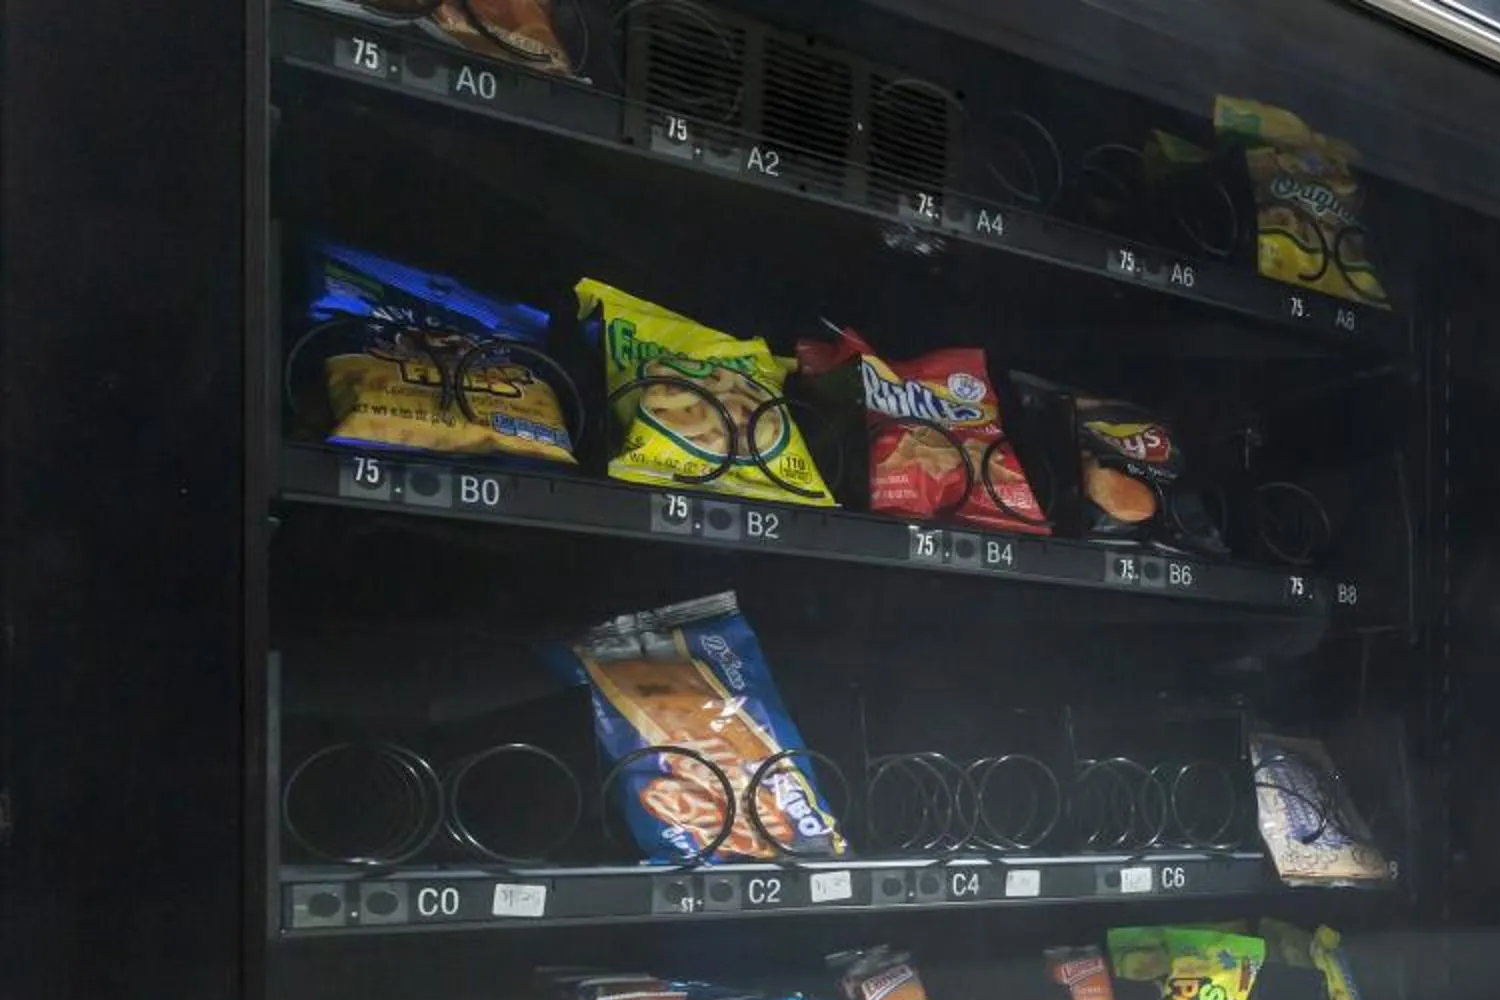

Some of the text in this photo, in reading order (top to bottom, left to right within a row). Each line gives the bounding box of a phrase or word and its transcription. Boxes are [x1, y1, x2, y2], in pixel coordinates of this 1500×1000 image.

[455, 66, 496, 99] A0
[747, 147, 779, 177] A2
[976, 209, 1004, 235] A4
[1170, 263, 1194, 287] A6
[1335, 309, 1355, 331] A8
[461, 475, 499, 506] B0
[747, 511, 779, 539] B2
[987, 541, 1013, 565] B4
[1169, 563, 1193, 585] B6
[1338, 584, 1357, 605] B8
[952, 873, 979, 896] C4
[1161, 867, 1185, 888] C6
[418, 887, 459, 916] C0
[748, 878, 781, 904] C2
